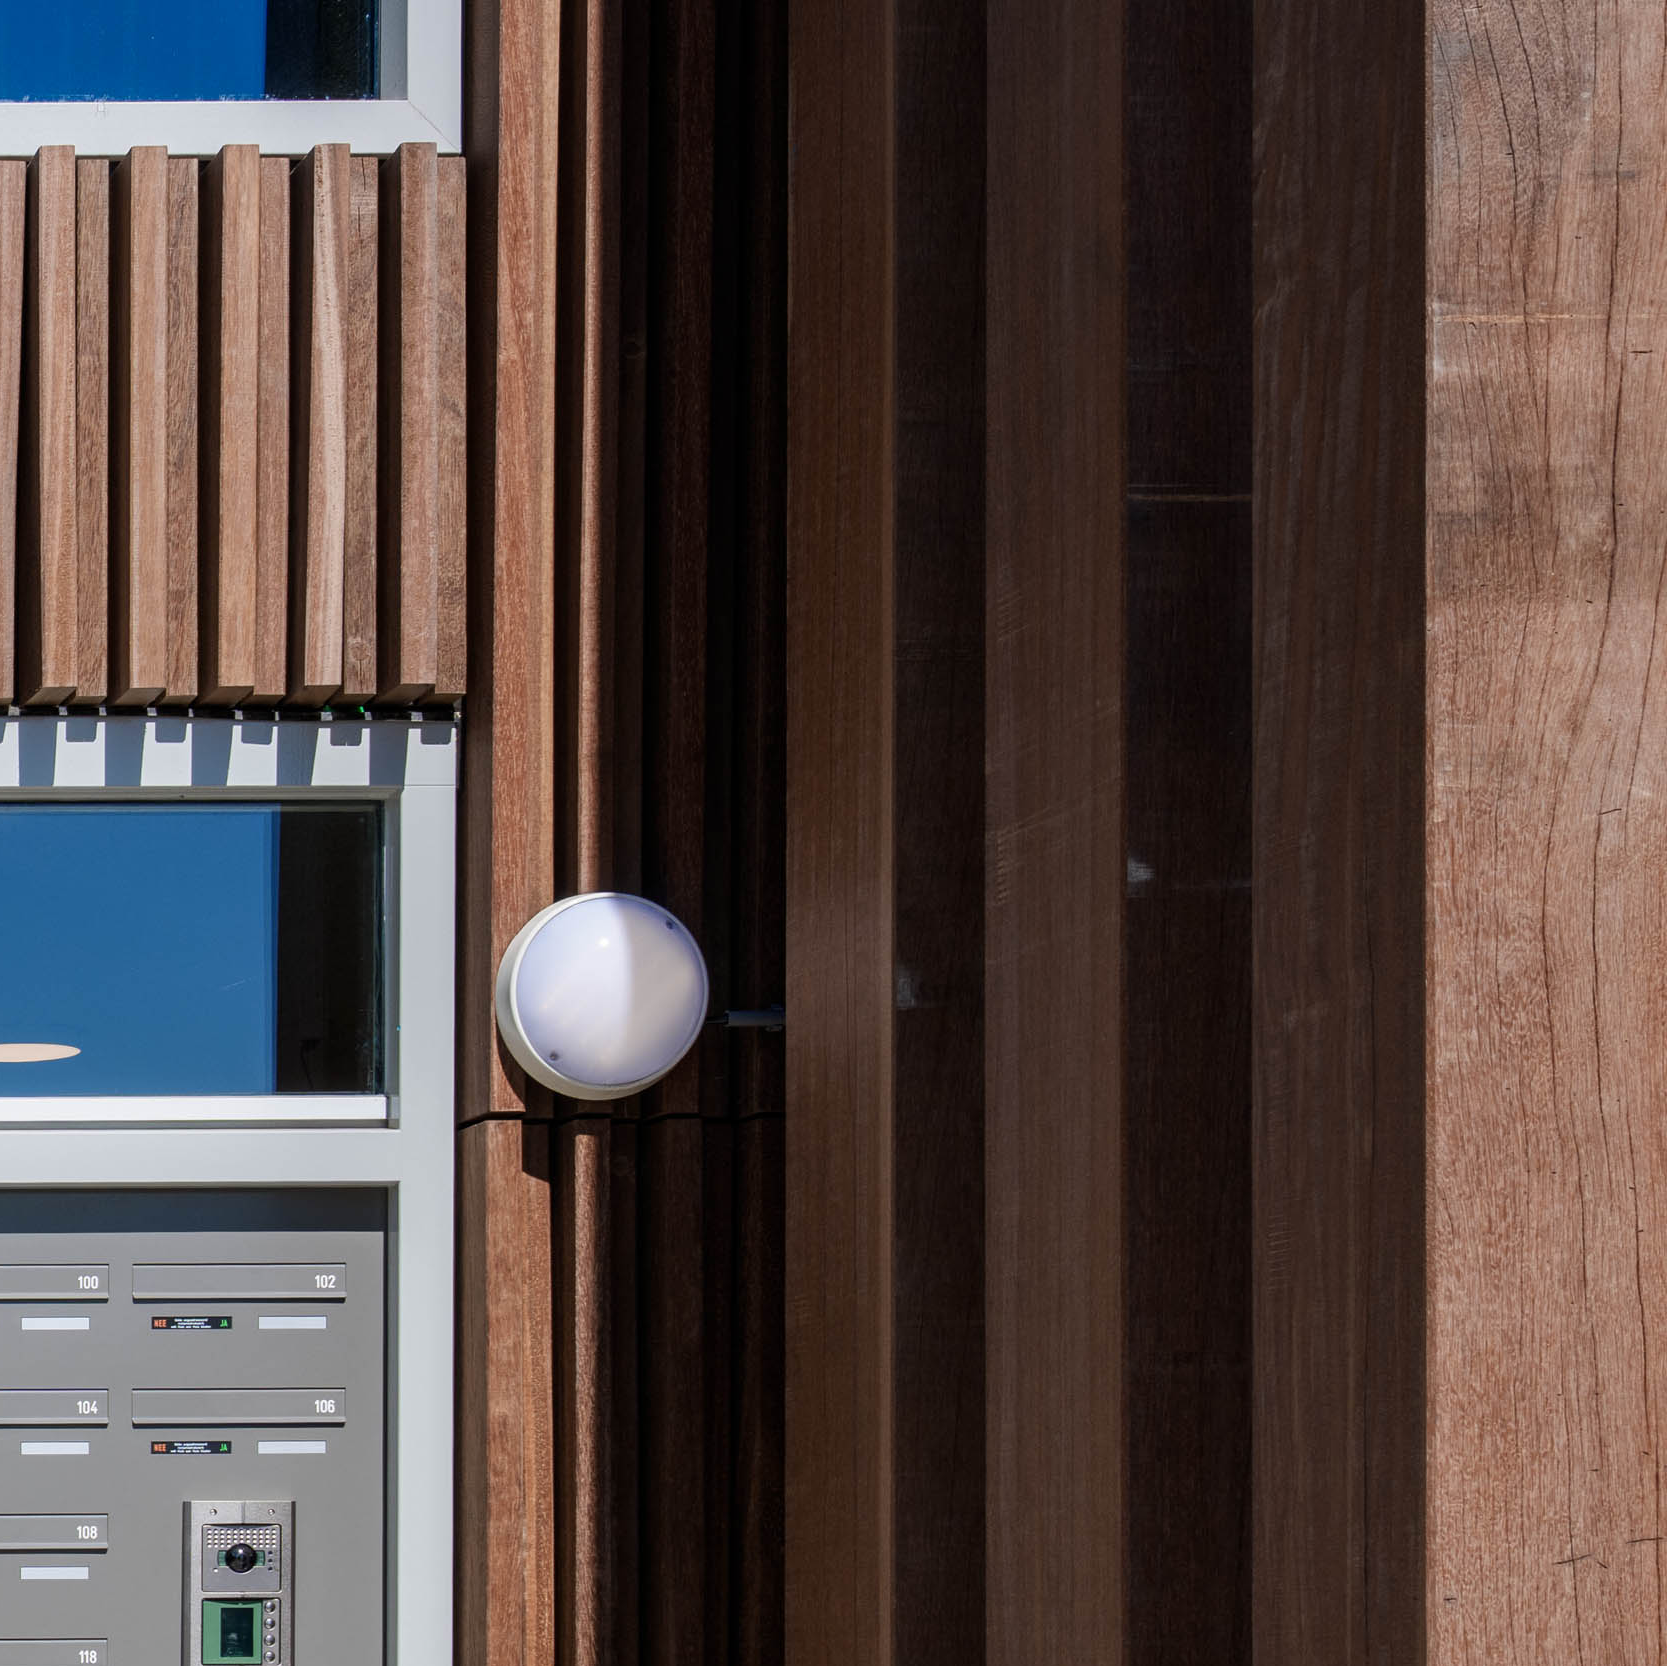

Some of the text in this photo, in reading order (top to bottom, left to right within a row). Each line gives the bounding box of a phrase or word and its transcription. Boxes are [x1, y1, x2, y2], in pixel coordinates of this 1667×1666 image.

[78, 1276, 99, 1289] 100
[315, 1275, 336, 1288] 102
[155, 1320, 167, 1328] NEE
[219, 1320, 227, 1328] JA
[77, 1401, 98, 1414] 104
[315, 1400, 335, 1413] 106
[154, 1444, 166, 1452] NEE
[219, 1444, 227, 1452] JA
[77, 1526, 98, 1539] 108
[79, 1650, 97, 1664] 118
